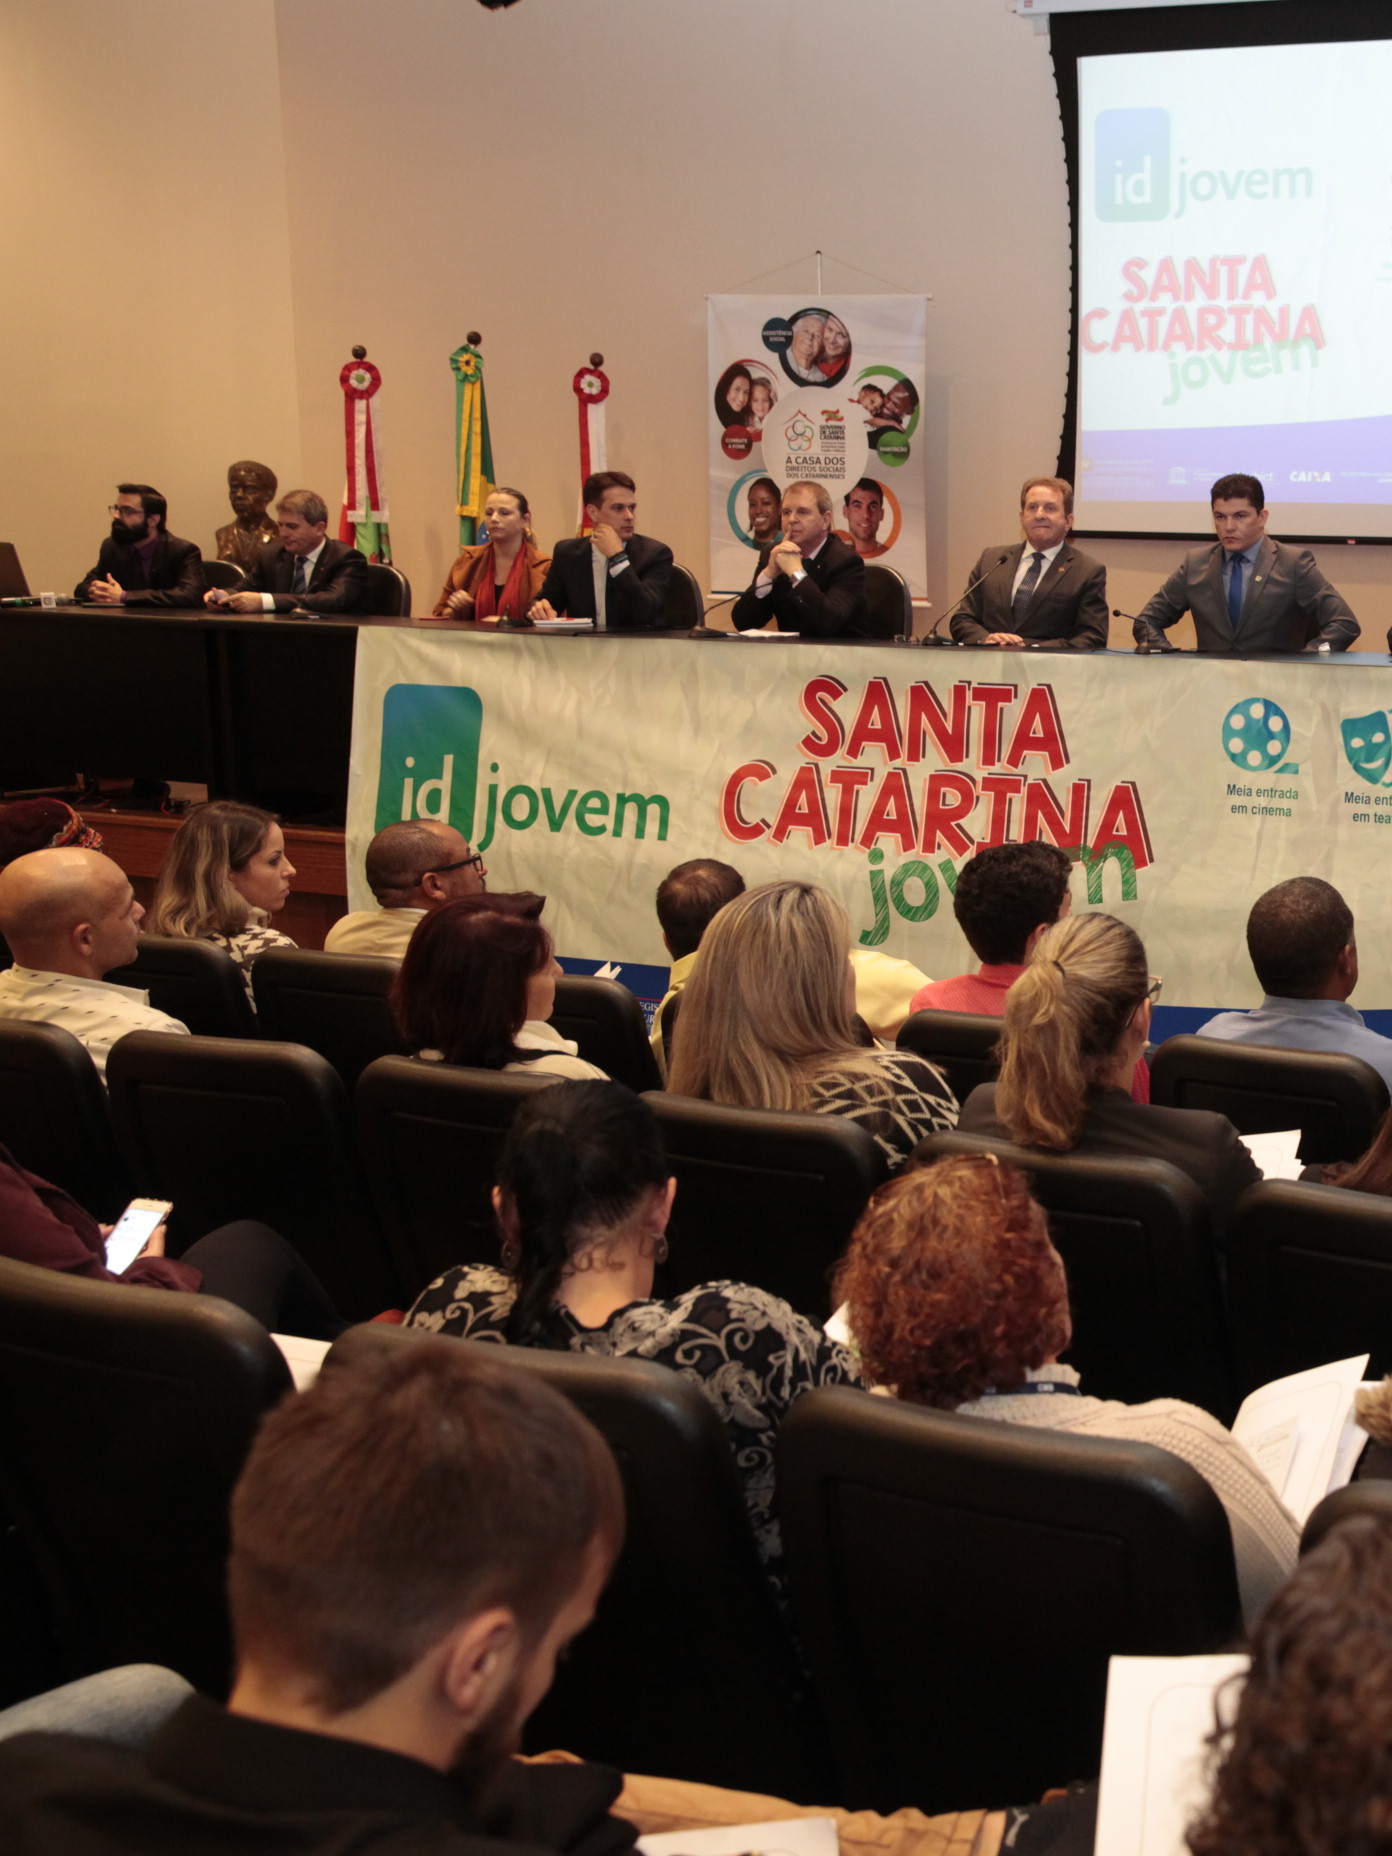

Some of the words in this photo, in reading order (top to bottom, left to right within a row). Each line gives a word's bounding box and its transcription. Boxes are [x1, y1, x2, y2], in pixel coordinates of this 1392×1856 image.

[1113, 154, 1152, 204] id
[1173, 156, 1314, 219] jovem
[1120, 253, 1277, 303] SANTA
[1081, 303, 1327, 354] CATARINA
[1161, 335, 1320, 406] jovem
[785, 456, 792, 465] A
[795, 456, 822, 465] CASA
[824, 456, 846, 466] DOS
[785, 465, 817, 473] DIREITOS
[1290, 470, 1332, 482] CAIXA
[797, 674, 1071, 775] SANTA
[401, 754, 454, 822] id
[477, 761, 670, 853] jovem
[718, 759, 1155, 872] CATARINA
[1226, 784, 1253, 797] Meia
[1256, 786, 1299, 800] entrada
[1231, 804, 1248, 815] em
[1251, 803, 1292, 818] cinema
[1344, 791, 1371, 805] Meia
[1352, 812, 1370, 823] em
[858, 839, 1138, 947] jom
